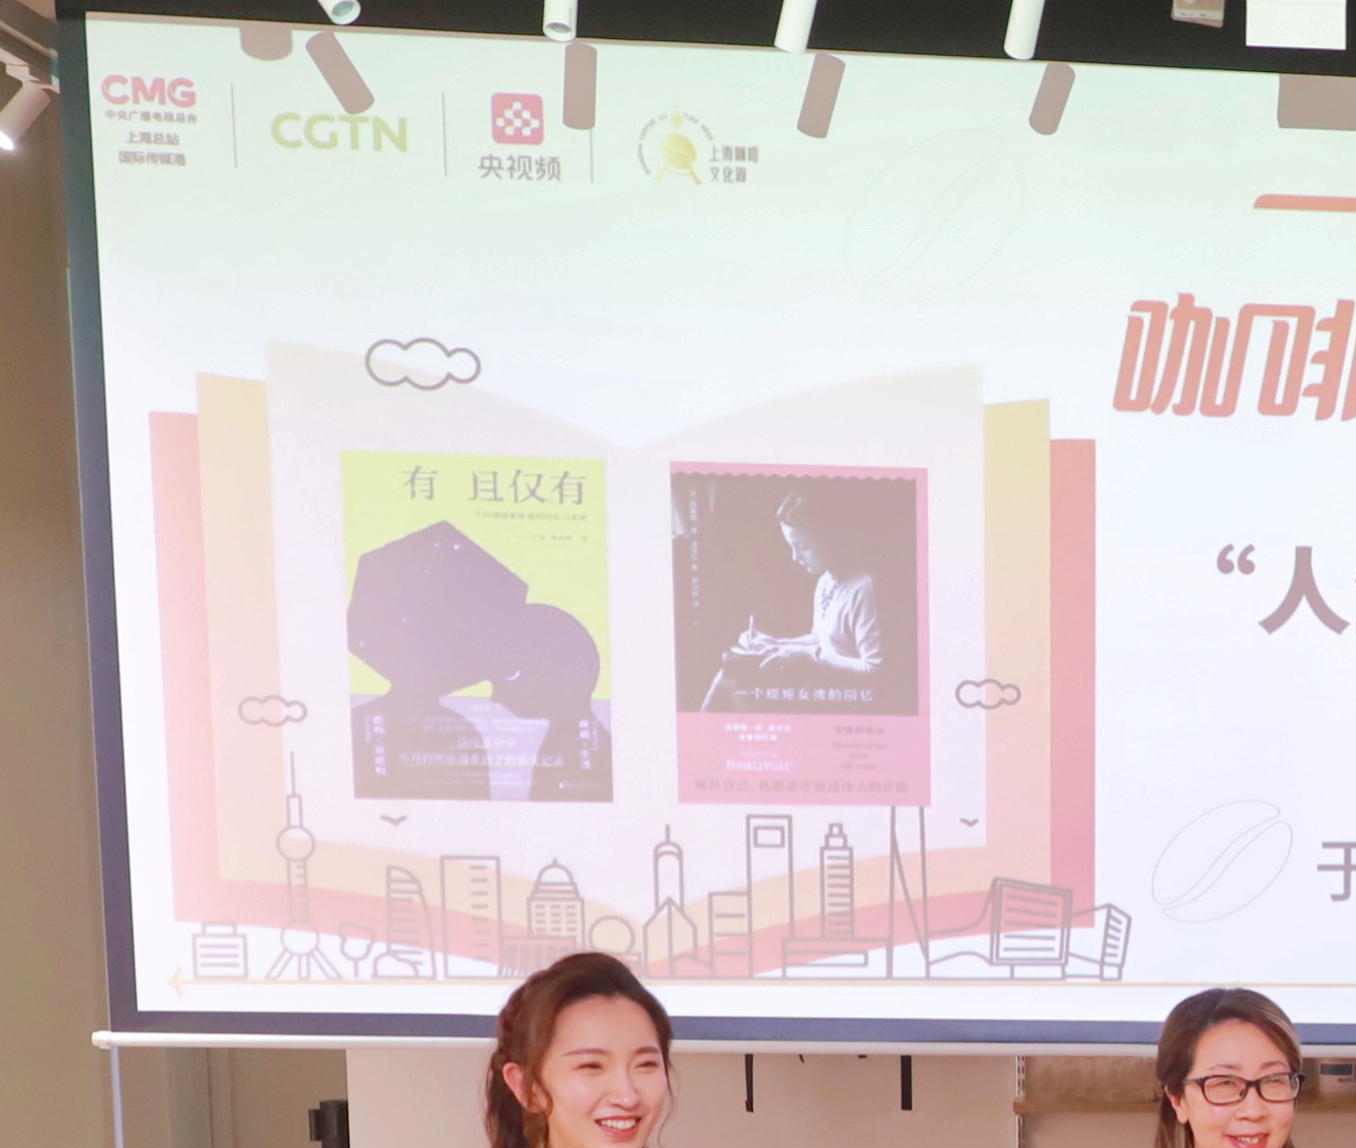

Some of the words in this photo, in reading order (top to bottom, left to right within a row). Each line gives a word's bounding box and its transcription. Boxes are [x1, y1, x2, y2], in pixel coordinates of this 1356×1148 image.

[101, 75, 196, 108] CMG
[270, 112, 408, 153] CGTN
[478, 154, 561, 181] 央视频
